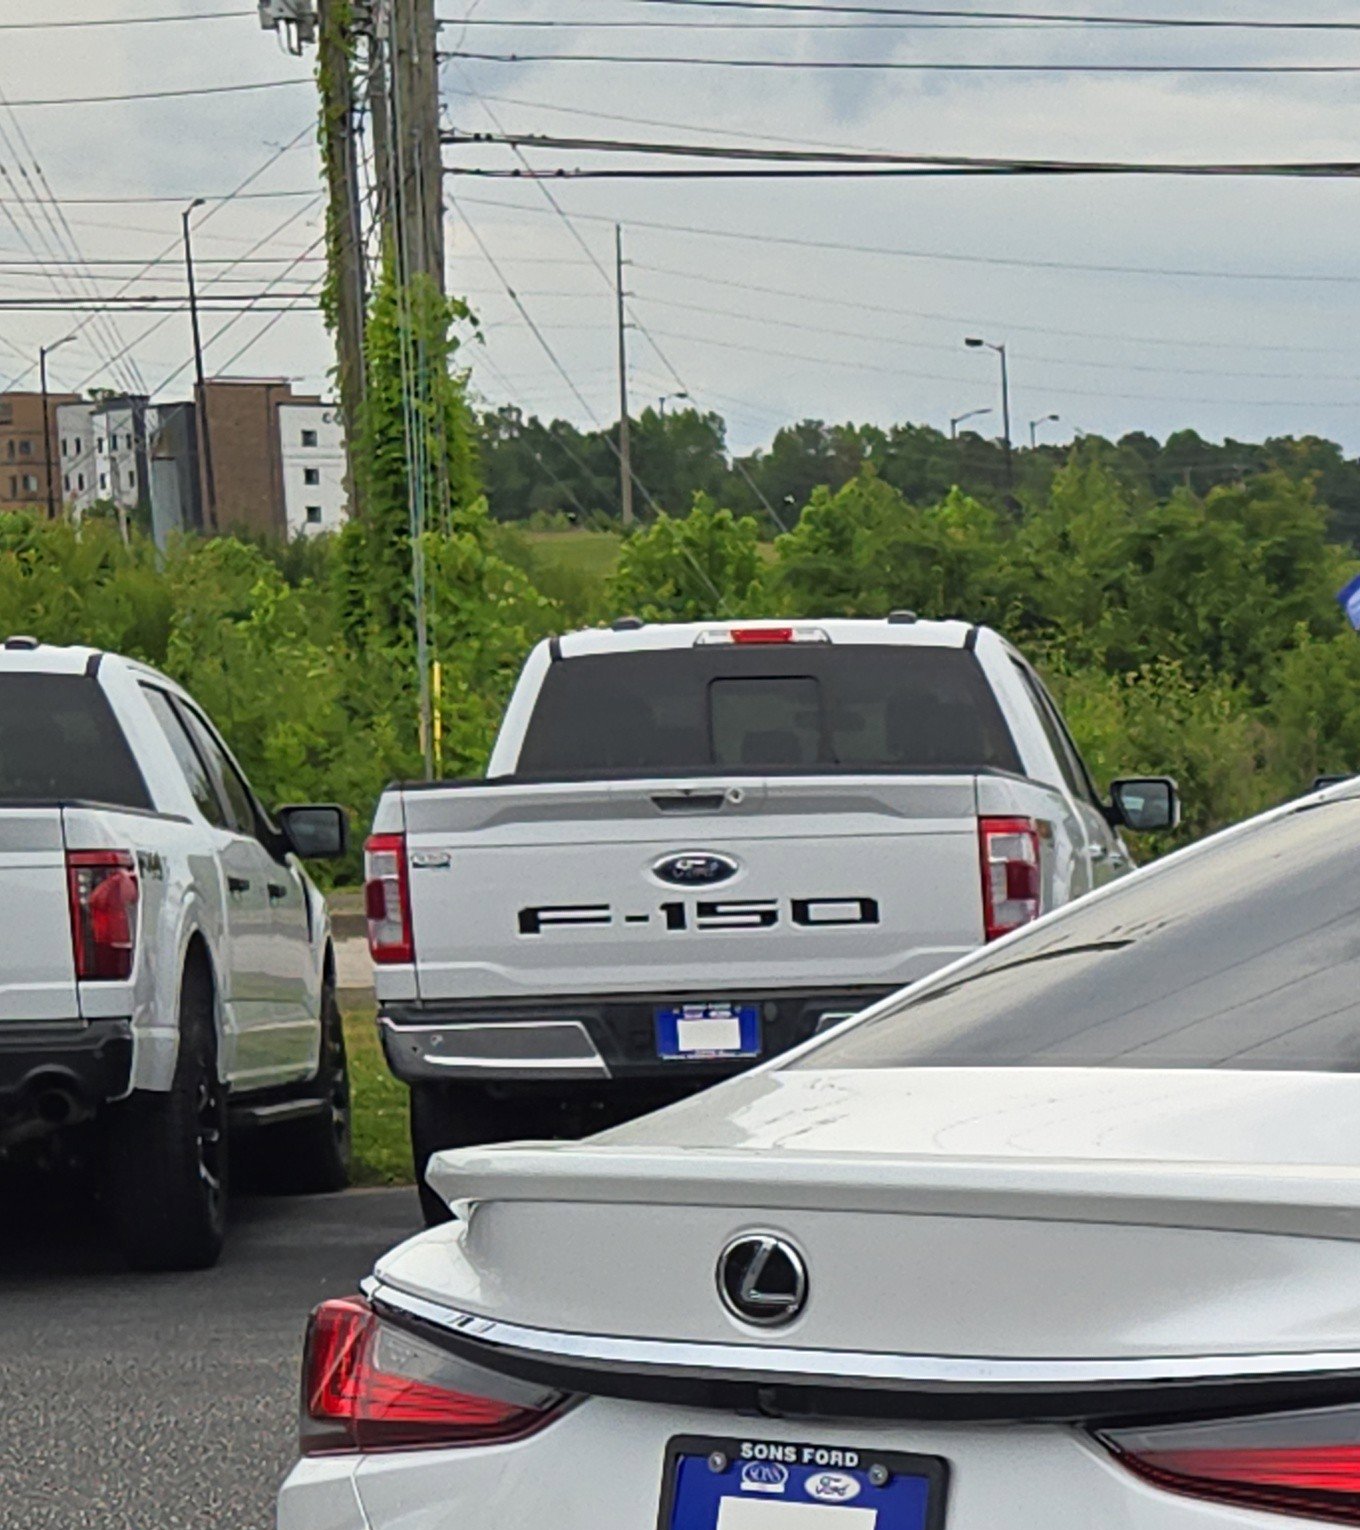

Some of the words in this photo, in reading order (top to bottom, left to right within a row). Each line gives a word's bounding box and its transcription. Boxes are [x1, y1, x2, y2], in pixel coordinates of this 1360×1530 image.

[517, 897, 880, 934] F-150
[740, 1442, 798, 1463] SONS
[801, 1448, 860, 1468] FORD
